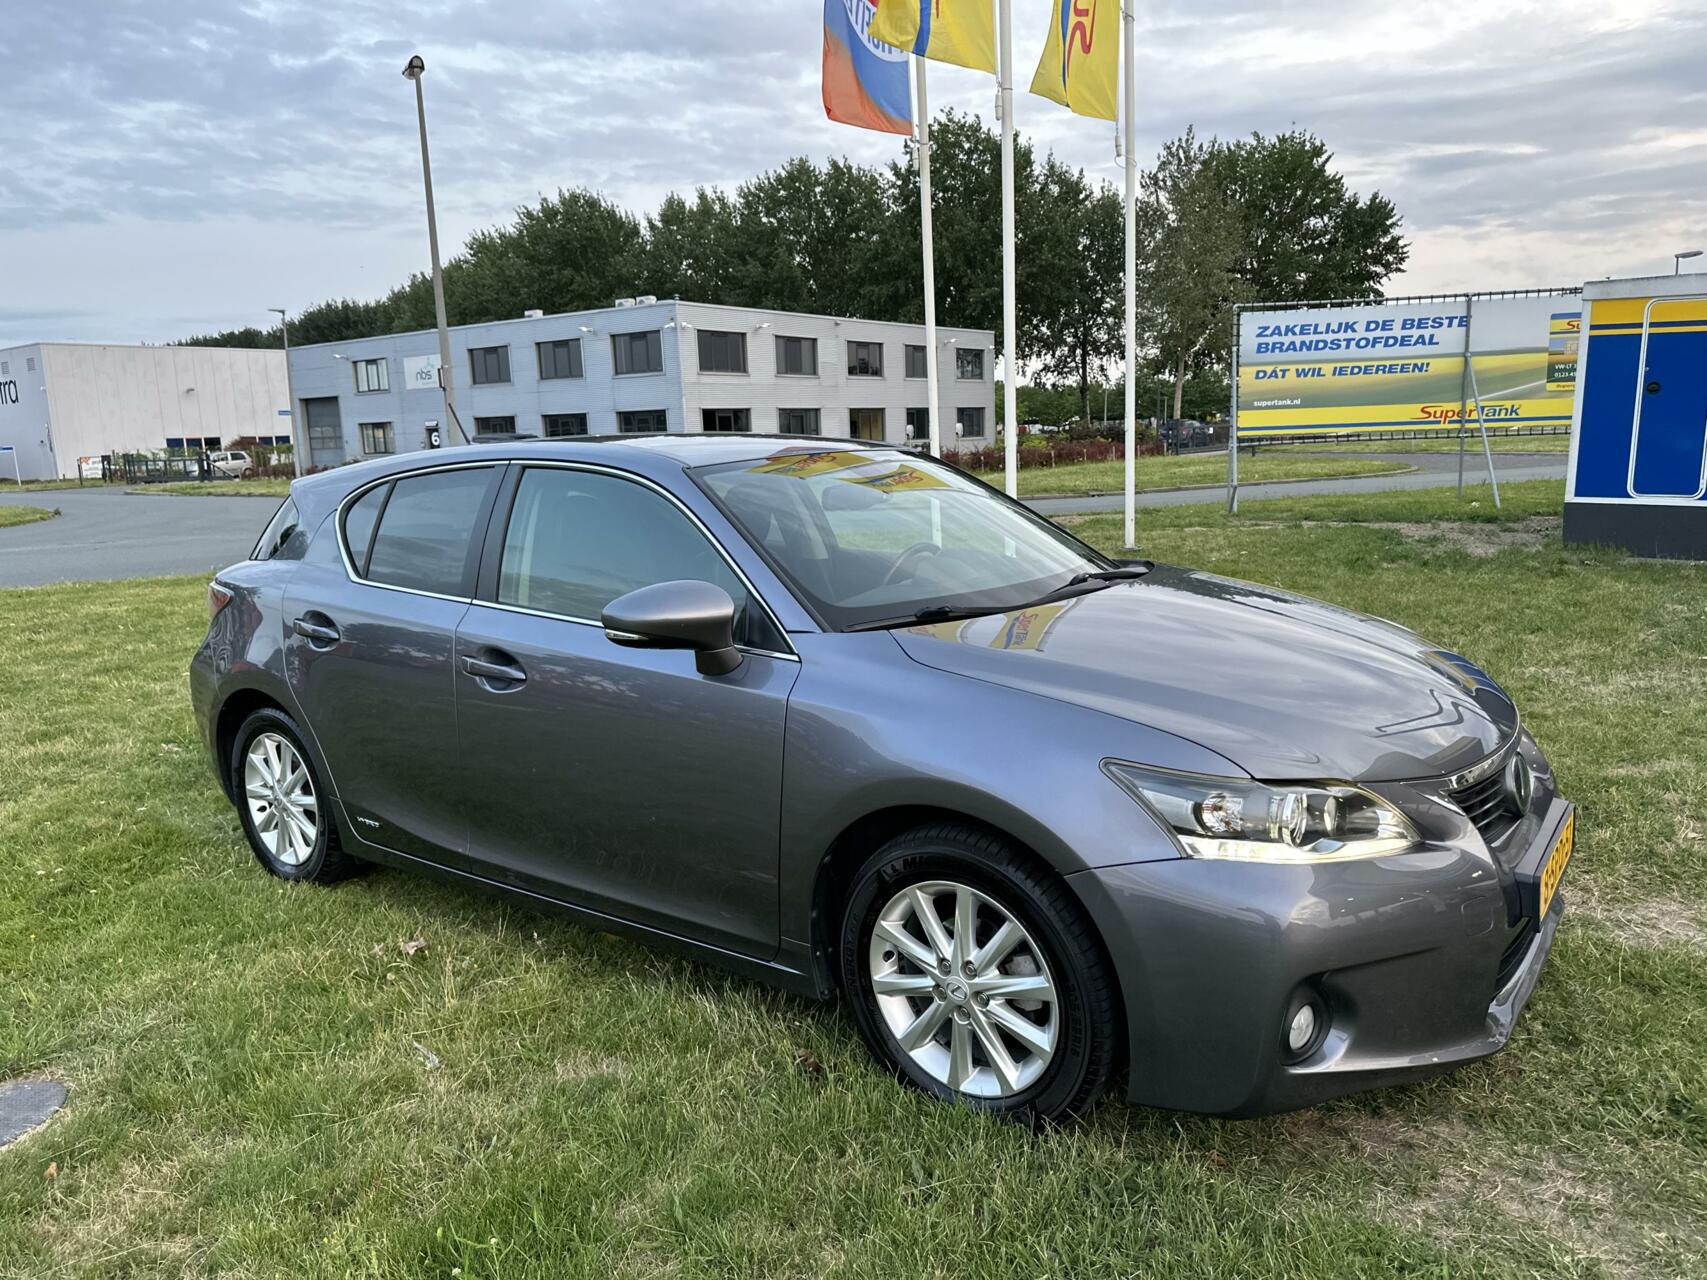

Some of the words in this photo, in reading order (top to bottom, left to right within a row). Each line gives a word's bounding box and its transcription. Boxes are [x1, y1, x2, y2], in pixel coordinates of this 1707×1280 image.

[1256, 321, 1359, 338] ZAKELIJK
[1365, 319, 1396, 332] DE
[1401, 315, 1468, 331] BESTE
[1256, 333, 1440, 354] BRANDSTOFDEAL
[1254, 366, 1291, 380] DÁT
[1295, 367, 1326, 379] WIL
[1332, 362, 1430, 377] IEDEREEN!
[1253, 398, 1301, 409] supertank.nl
[431, 432, 440, 445] 6
